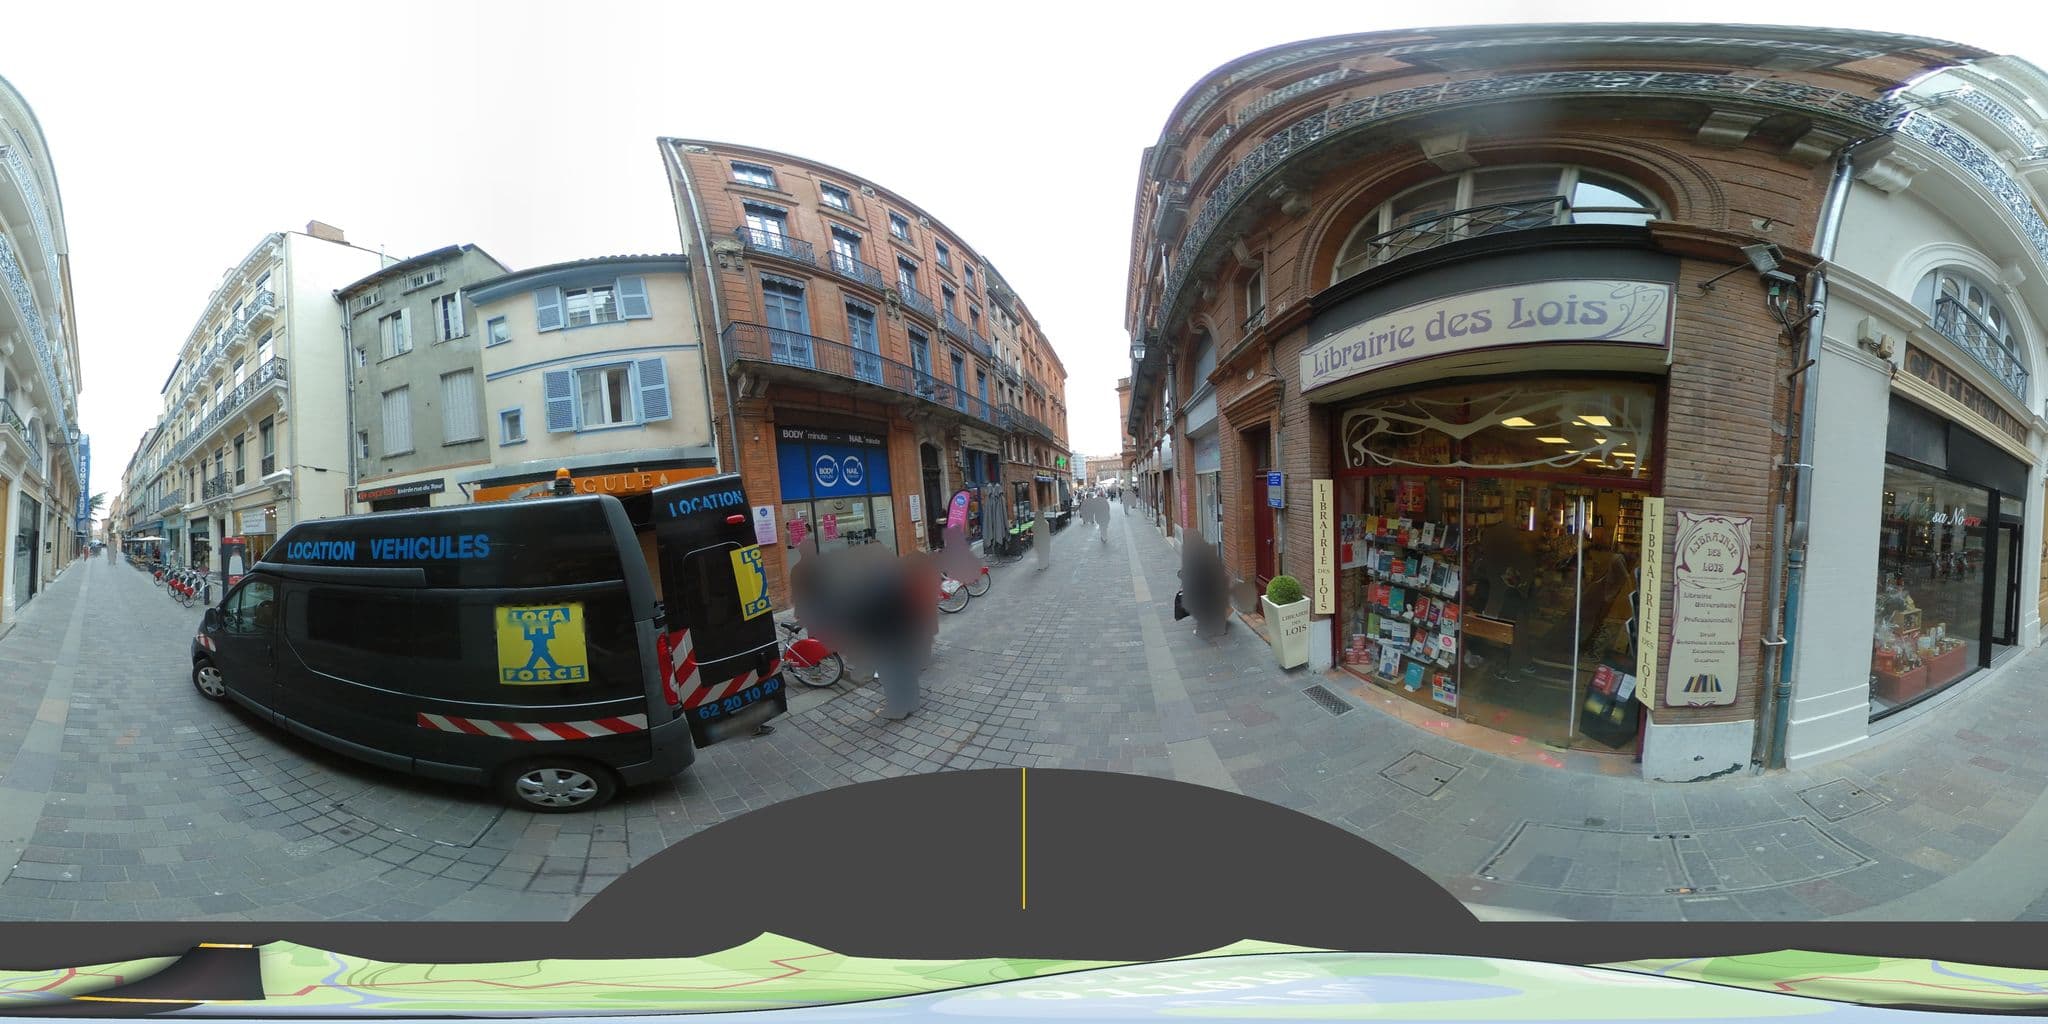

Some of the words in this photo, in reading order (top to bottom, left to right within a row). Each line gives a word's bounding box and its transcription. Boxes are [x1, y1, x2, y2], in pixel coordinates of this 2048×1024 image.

[1312, 324, 1416, 379] Librairie
[1424, 310, 1494, 342] des
[1507, 294, 1609, 330] Lois
[782, 429, 804, 439] BODY
[848, 434, 864, 443] NAIL
[818, 467, 833, 475] BODY
[668, 490, 744, 518] LOCATION
[1319, 483, 1328, 565] LIBRAIRIE
[287, 540, 356, 561] LOCATION
[370, 533, 491, 560] VEHICULES
[1689, 532, 1739, 558] LIBRAIRIE
[1707, 548, 1721, 557] DES
[1645, 503, 1657, 634] LIBRAIRIE
[1702, 562, 1724, 573] LOIS
[1319, 577, 1328, 611] LOIS
[511, 609, 565, 622] LOCA
[1286, 624, 1307, 637] LOIS
[1640, 636, 1654, 650] DES
[505, 667, 583, 681] FORCE
[1641, 651, 1651, 699] LOIS
[699, 703, 720, 719] 62
[723, 695, 742, 712] 20
[744, 687, 761, 702] 10
[763, 678, 779, 695] 20
